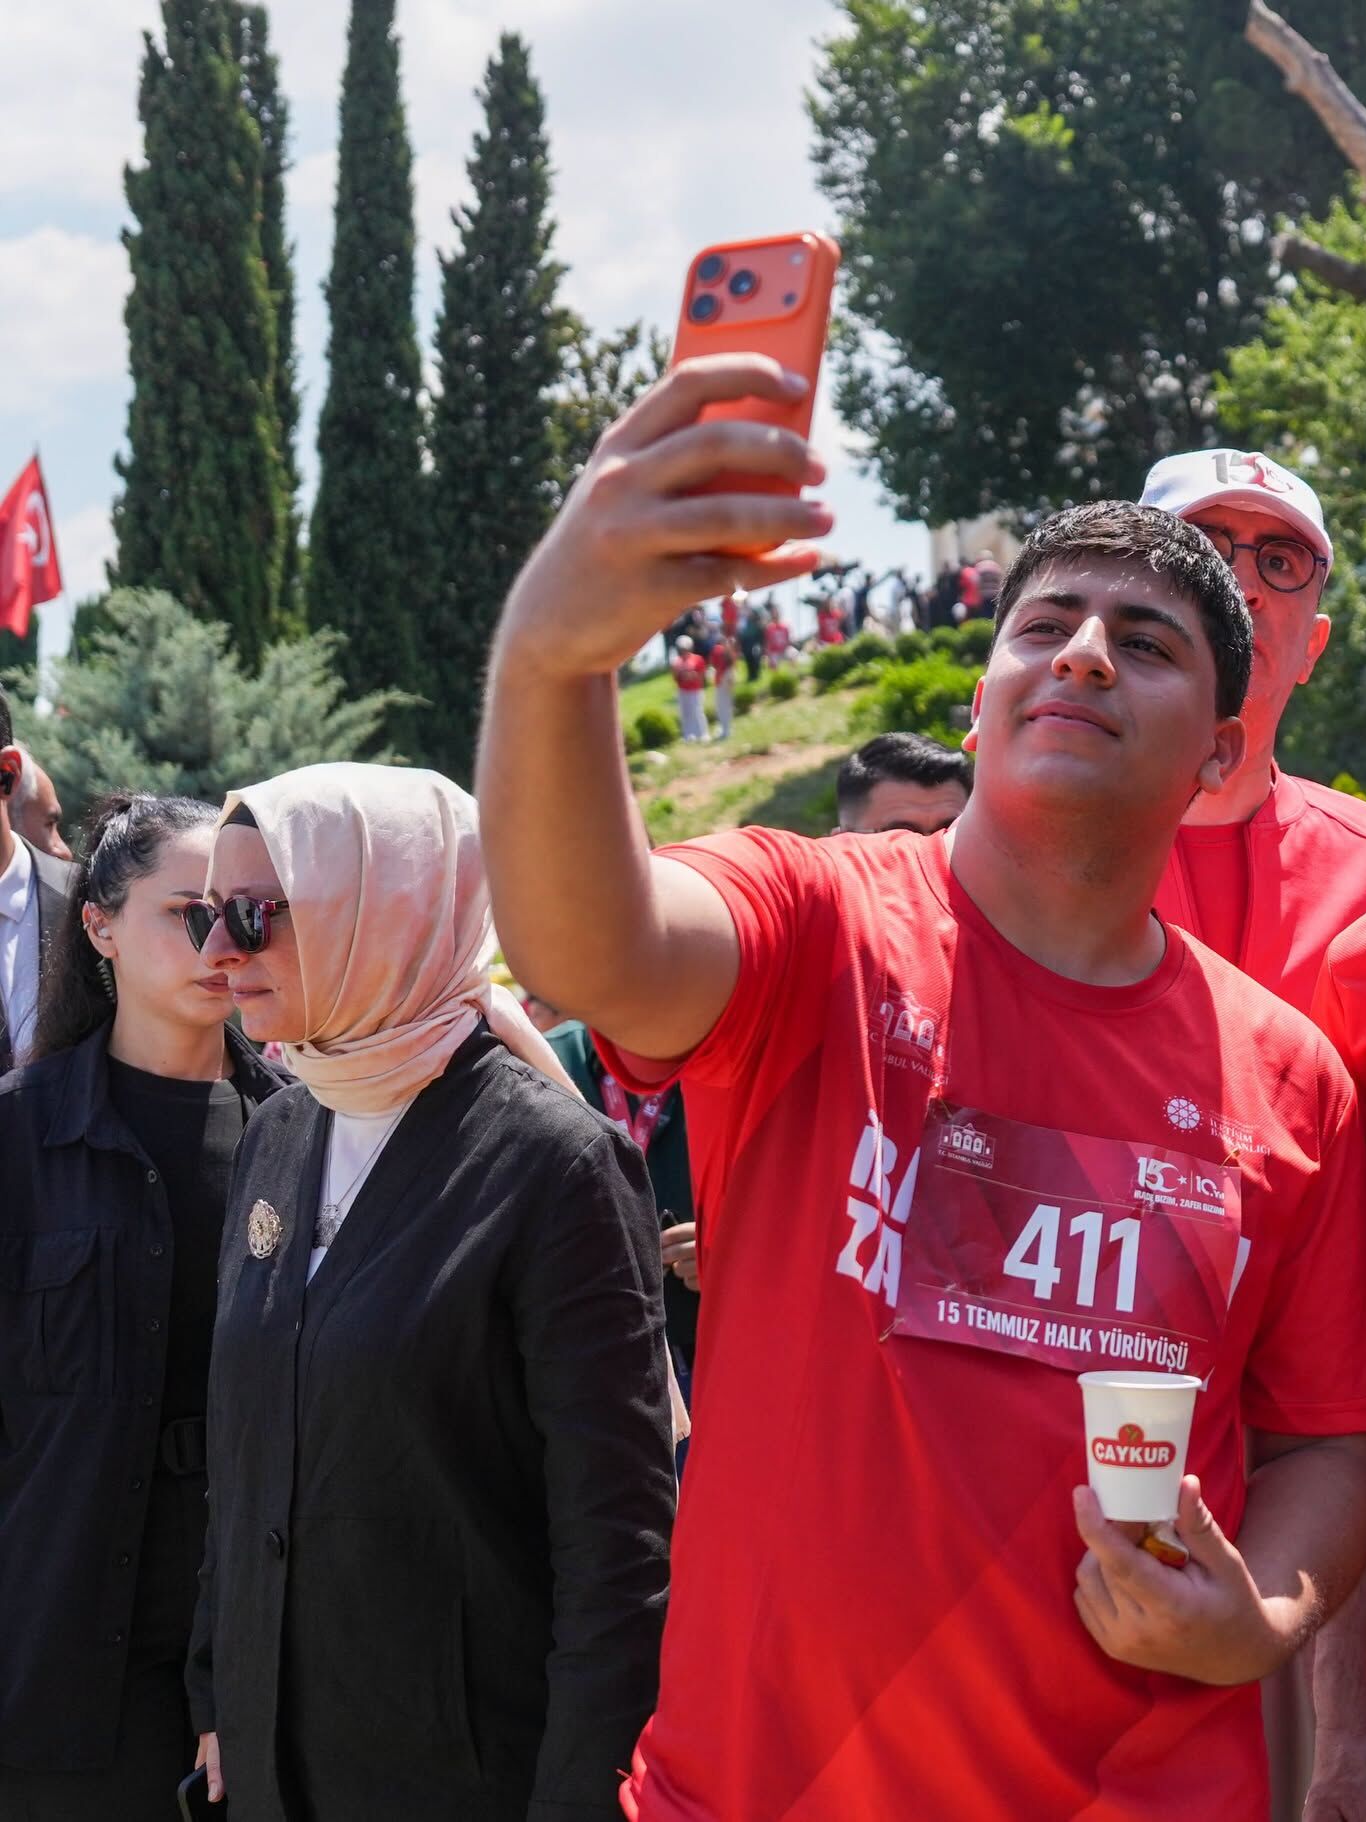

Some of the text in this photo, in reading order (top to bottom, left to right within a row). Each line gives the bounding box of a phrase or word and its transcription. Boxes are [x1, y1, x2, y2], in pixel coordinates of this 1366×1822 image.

[1179, 1199, 1202, 1210] ZAFER
[1003, 1204, 1142, 1314] 411
[937, 1300, 1188, 1373] 15 TEMMUZ HALK YÜRÜYÜŞÜ
